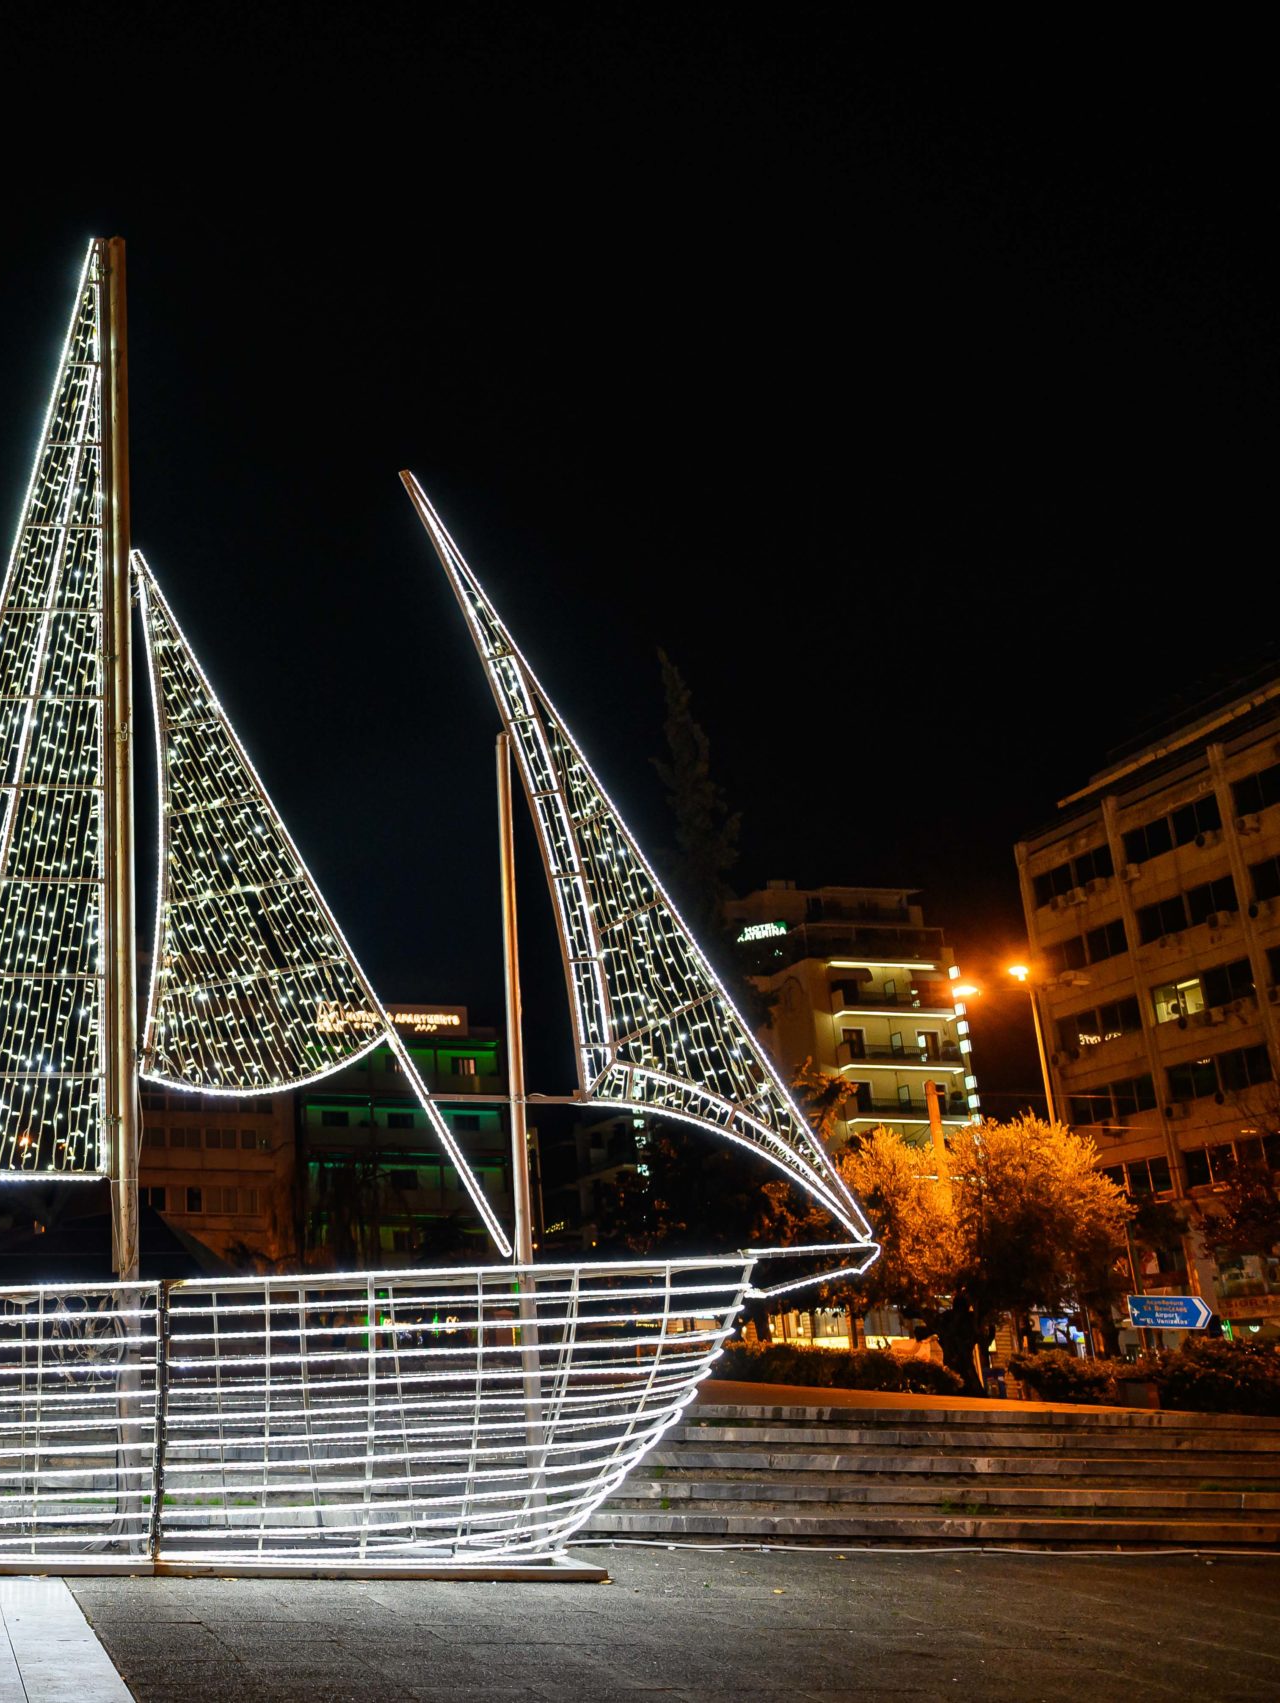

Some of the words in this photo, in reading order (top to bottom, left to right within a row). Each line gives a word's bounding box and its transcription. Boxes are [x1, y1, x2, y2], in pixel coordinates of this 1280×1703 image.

[744, 923, 777, 934] HOTEL
[395, 1013, 460, 1025] APARTMENTS
[1155, 1311, 1179, 1319] Airport
